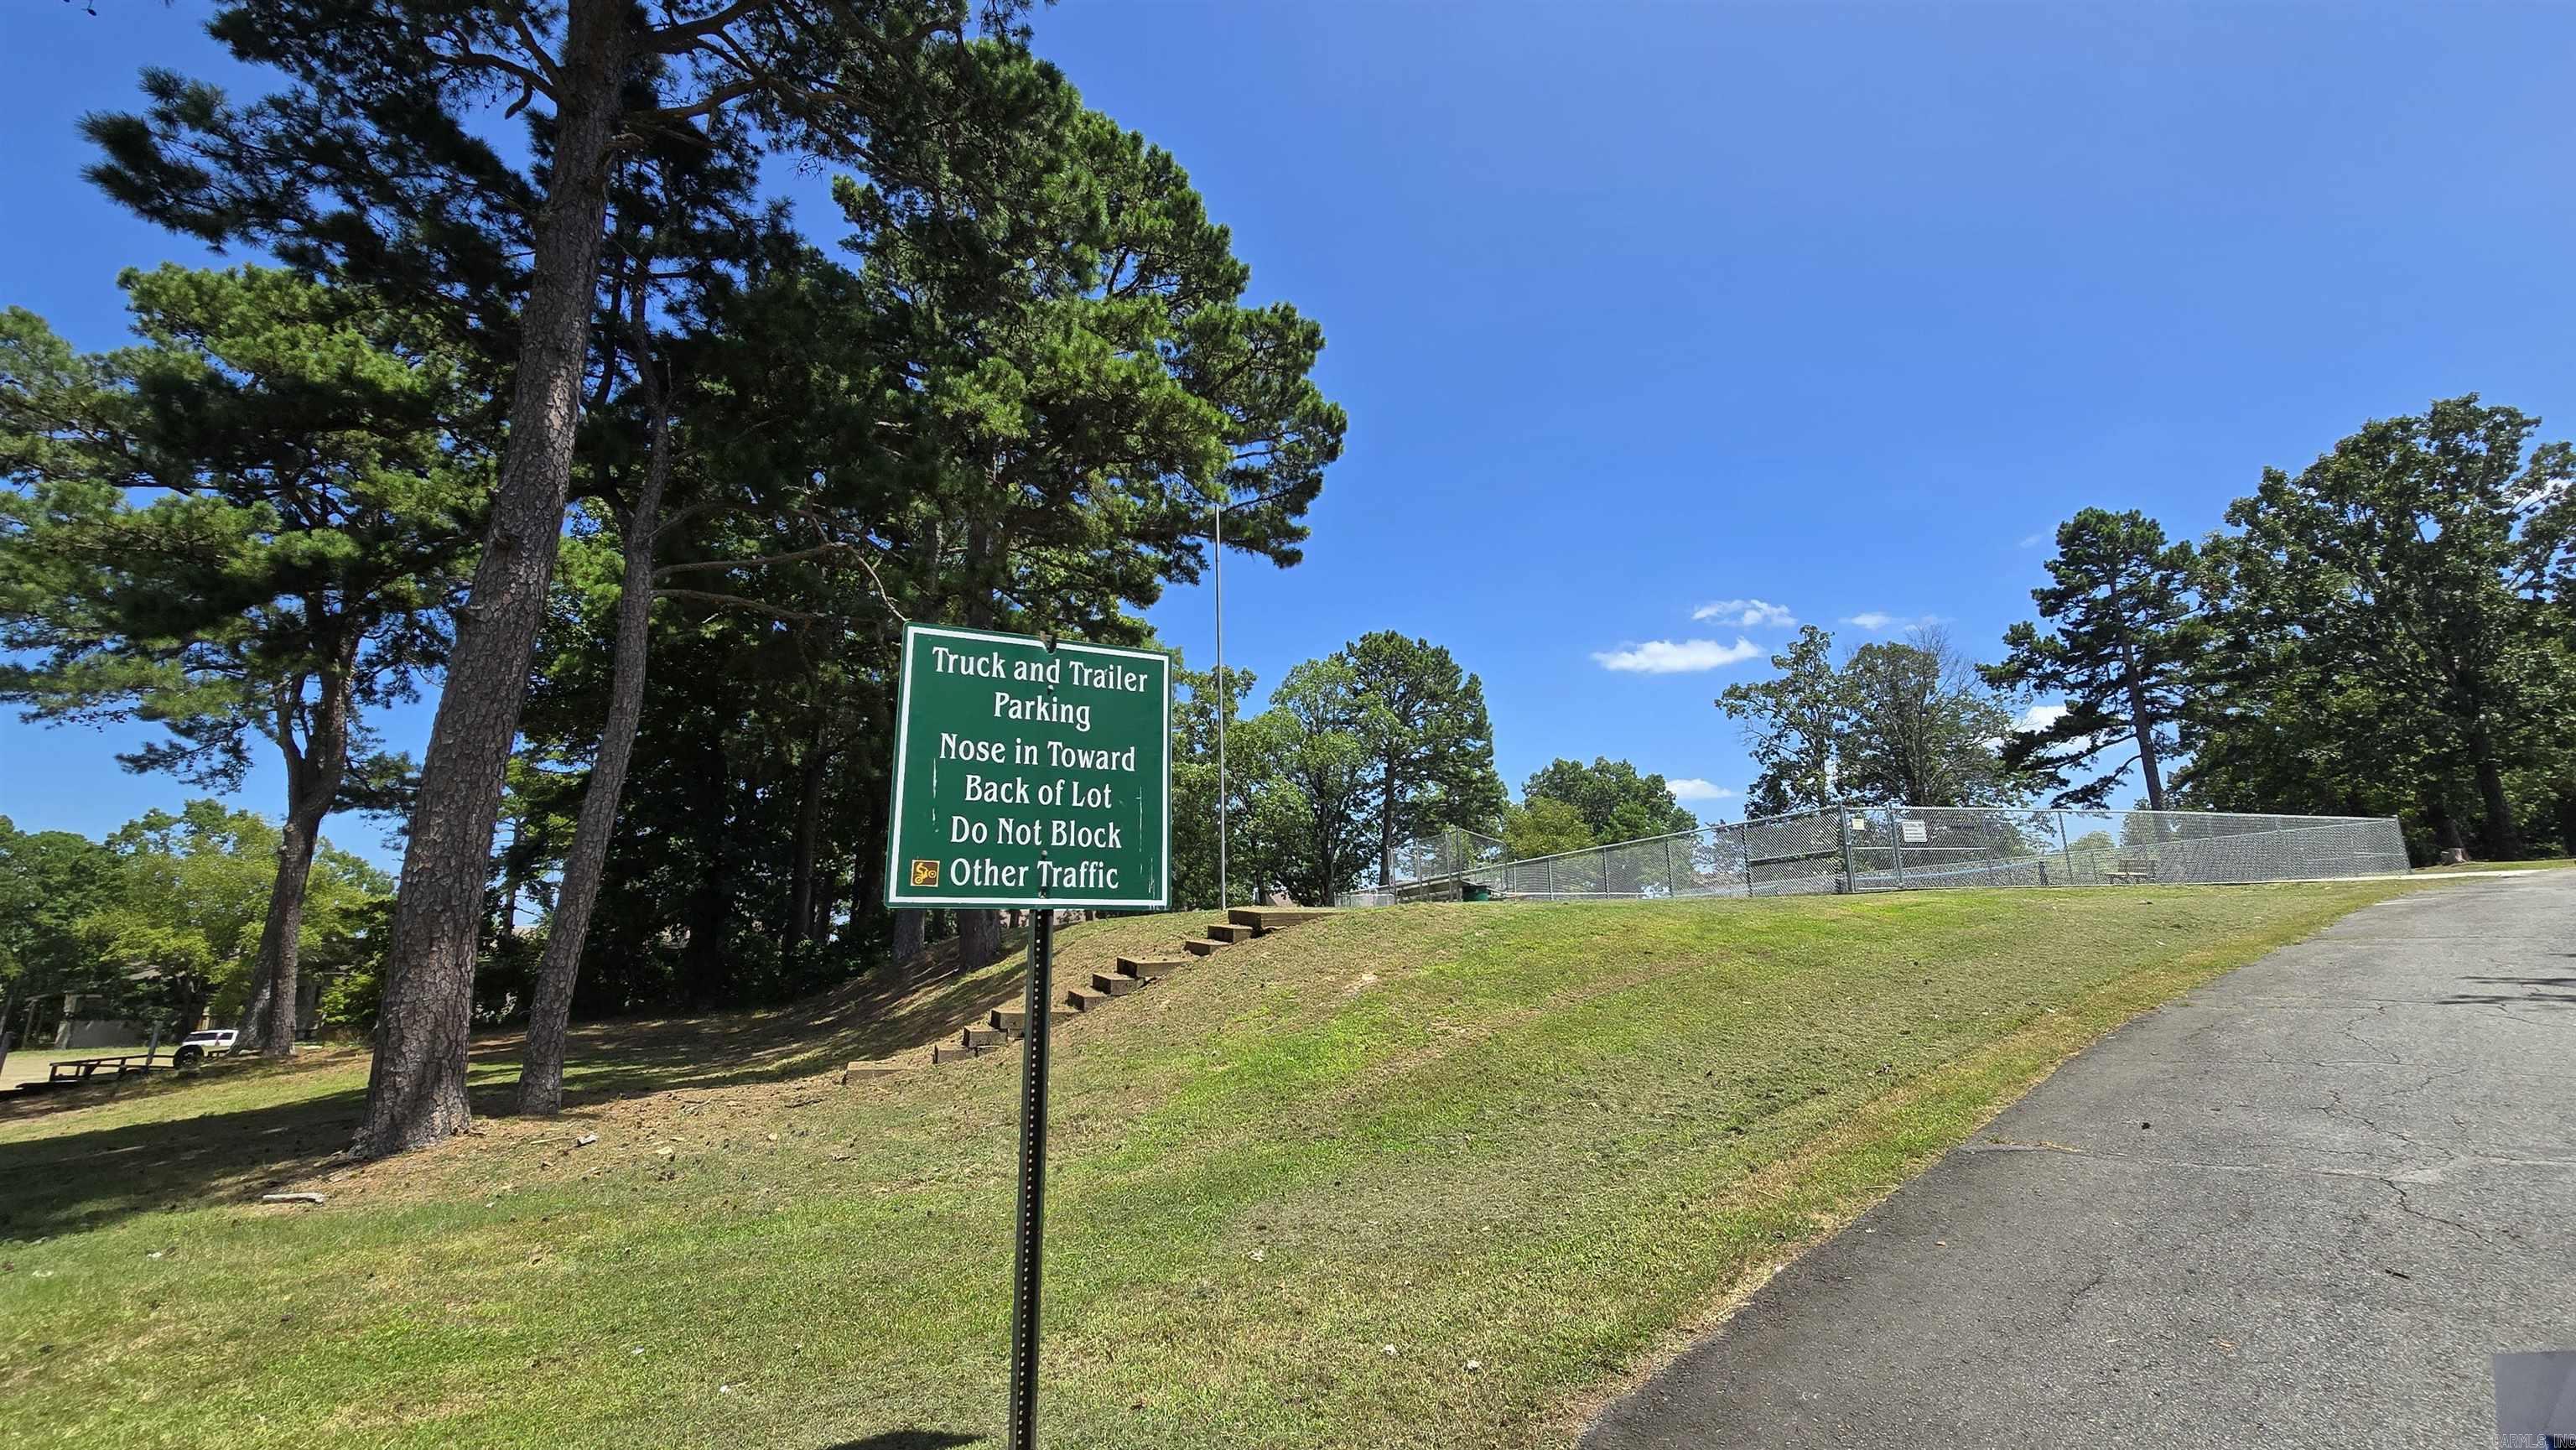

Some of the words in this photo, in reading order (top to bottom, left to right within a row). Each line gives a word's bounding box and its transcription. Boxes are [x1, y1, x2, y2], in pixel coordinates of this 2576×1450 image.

[932, 646, 1006, 678] Truck
[1013, 658, 1061, 684] and
[1068, 660, 1148, 693] Trailer
[994, 691, 1091, 732] Parking
[939, 732, 1006, 764] Nose
[1015, 737, 1039, 766] in
[1046, 741, 1135, 772] Toward
[964, 774, 1031, 804] Back
[1038, 778, 1066, 806] of
[1072, 781, 1112, 808] Lot
[950, 815, 988, 844] Do
[997, 818, 1042, 846] Not
[1051, 819, 1122, 849] Block
[950, 858, 1029, 886] Other
[1036, 860, 1119, 890] Traffic
